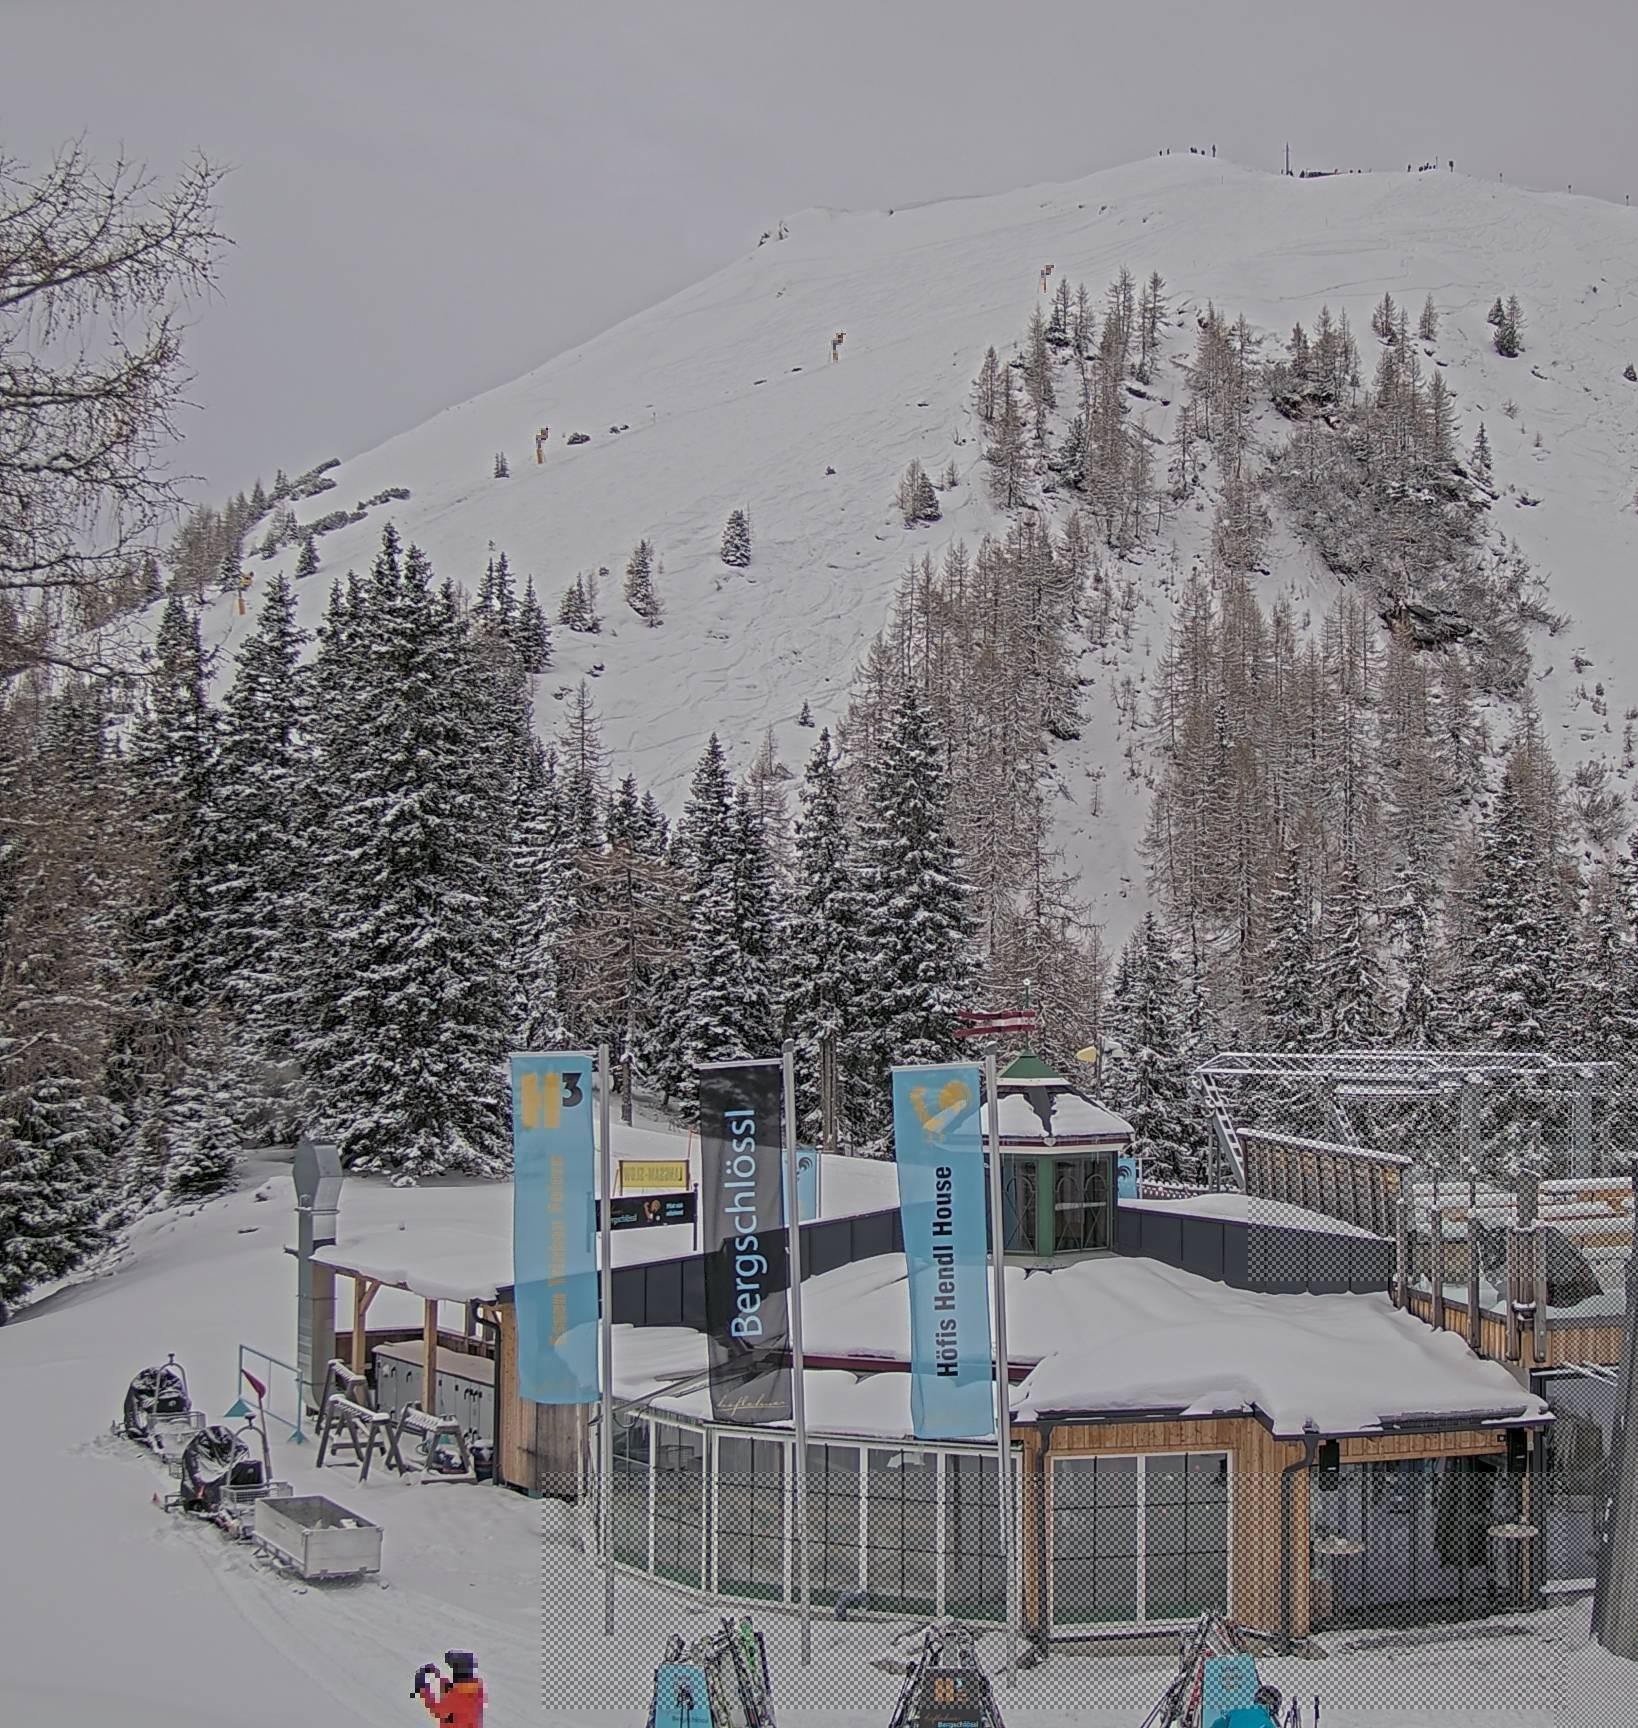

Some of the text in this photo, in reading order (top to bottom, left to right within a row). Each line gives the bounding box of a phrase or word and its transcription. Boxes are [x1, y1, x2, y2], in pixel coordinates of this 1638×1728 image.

[724, 1109, 768, 1338] Bergschlössl
[932, 1166, 959, 1377] Höfis Hendl House
